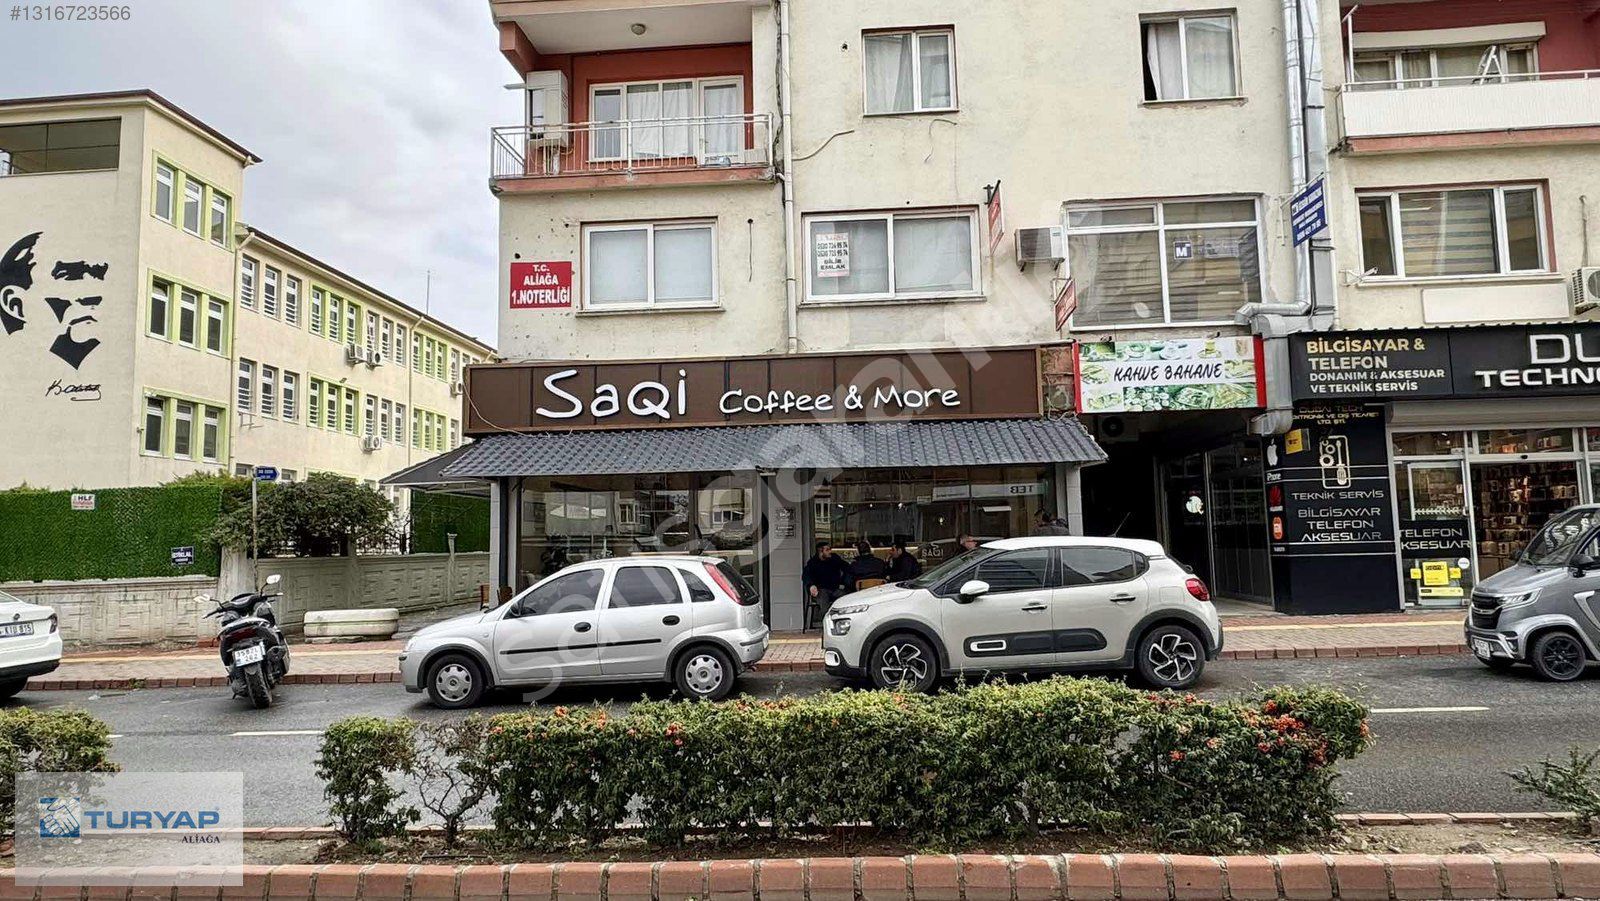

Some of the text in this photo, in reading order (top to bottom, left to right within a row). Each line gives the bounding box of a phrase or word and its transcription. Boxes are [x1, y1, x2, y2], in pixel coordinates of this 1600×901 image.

[532, 264, 549, 272] T.C.
[523, 273, 559, 286] ALİAĞA
[511, 286, 571, 304] 1.NOTERLİĞİ
[1306, 337, 1425, 353] BİLGİSAYAR &
[1308, 356, 1388, 370] TELEFON
[1165, 363, 1222, 380] BAHANE
[1309, 371, 1367, 382] DONANIM
[1380, 369, 1445, 379] AKSESUAR
[1475, 367, 1600, 387] TECHN
[1310, 381, 1418, 393] VE TEKNİK SERVİS
[719, 388, 833, 413] Coffee
[844, 385, 864, 410] &
[873, 385, 961, 408] More
[1292, 489, 1384, 500] TEKNİK SERVİS
[1297, 506, 1381, 519] BİLGİSAYAR
[1307, 520, 1374, 530] TELEFON
[1301, 532, 1382, 542] AKSESUAR
[1401, 540, 1471, 550] KSESUAR
